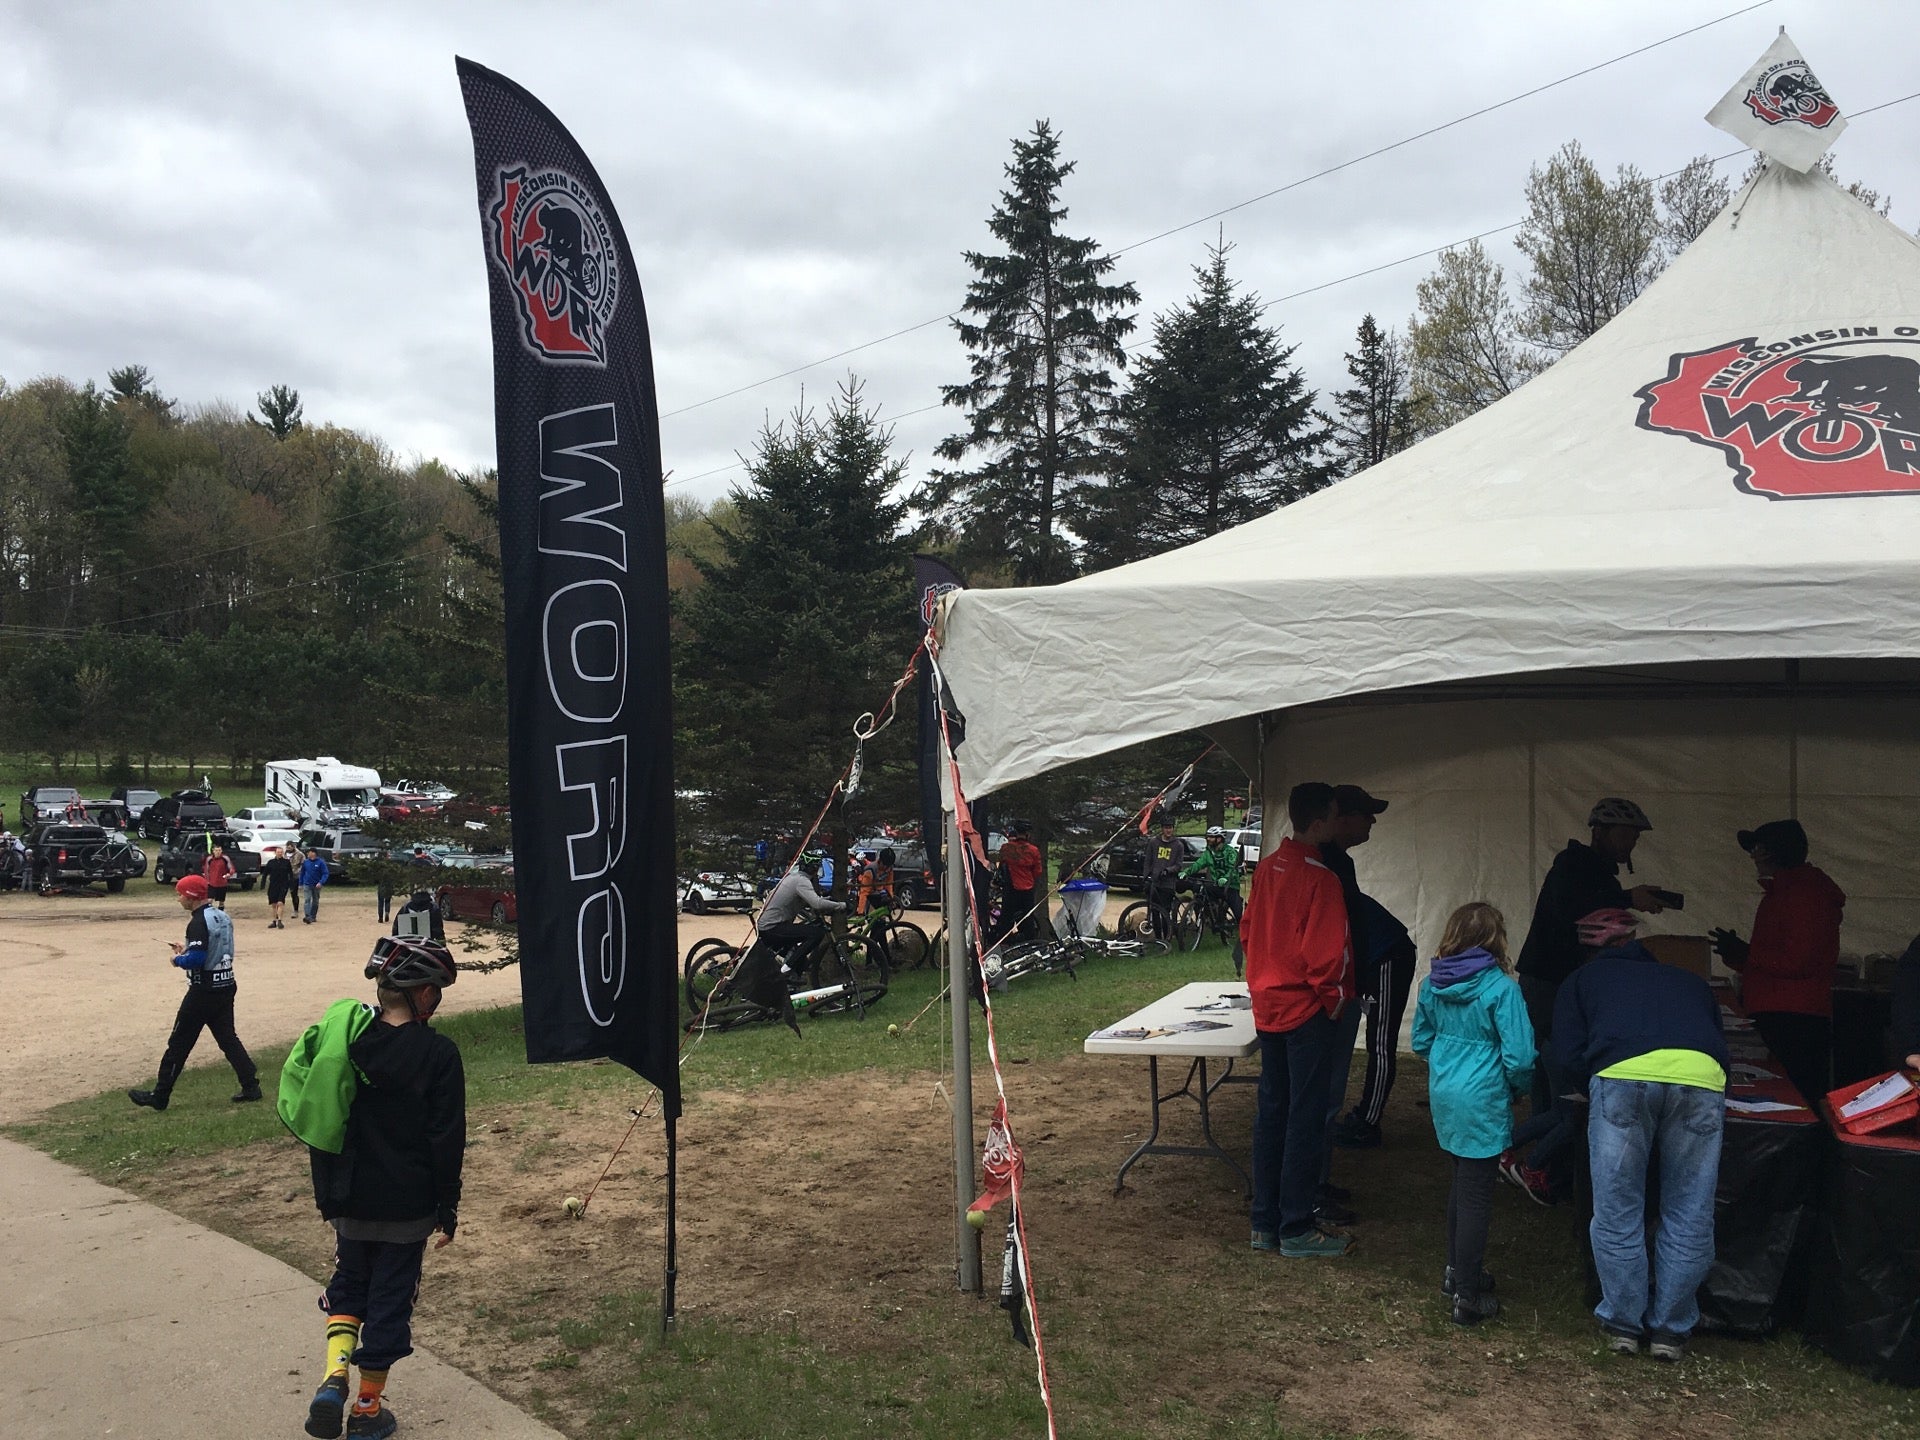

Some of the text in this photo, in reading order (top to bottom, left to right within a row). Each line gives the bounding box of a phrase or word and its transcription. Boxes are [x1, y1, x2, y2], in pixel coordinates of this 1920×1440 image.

[1768, 63, 1784, 73] OFF
[513, 172, 617, 322] WISCONSIN OFF ROAD SERIES
[1707, 326, 1878, 389] WISCONSIN
